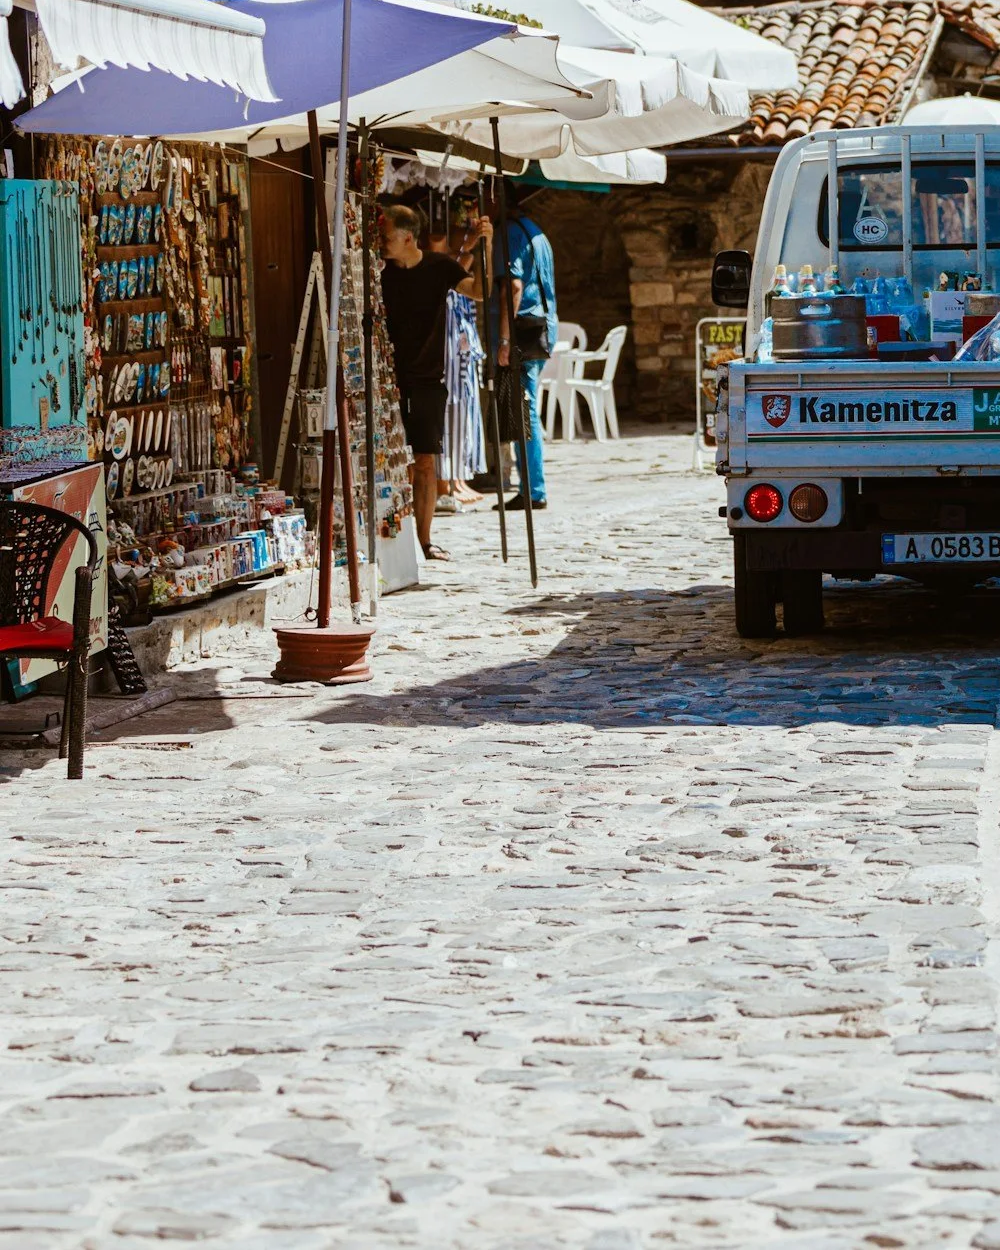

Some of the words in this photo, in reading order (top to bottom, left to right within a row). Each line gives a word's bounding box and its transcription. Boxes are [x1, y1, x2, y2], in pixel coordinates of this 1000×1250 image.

[862, 225, 879, 235] HC
[709, 325, 744, 343] FAST
[799, 396, 957, 423] Kamenitza
[905, 537, 919, 559] A
[931, 536, 985, 558] 0583
